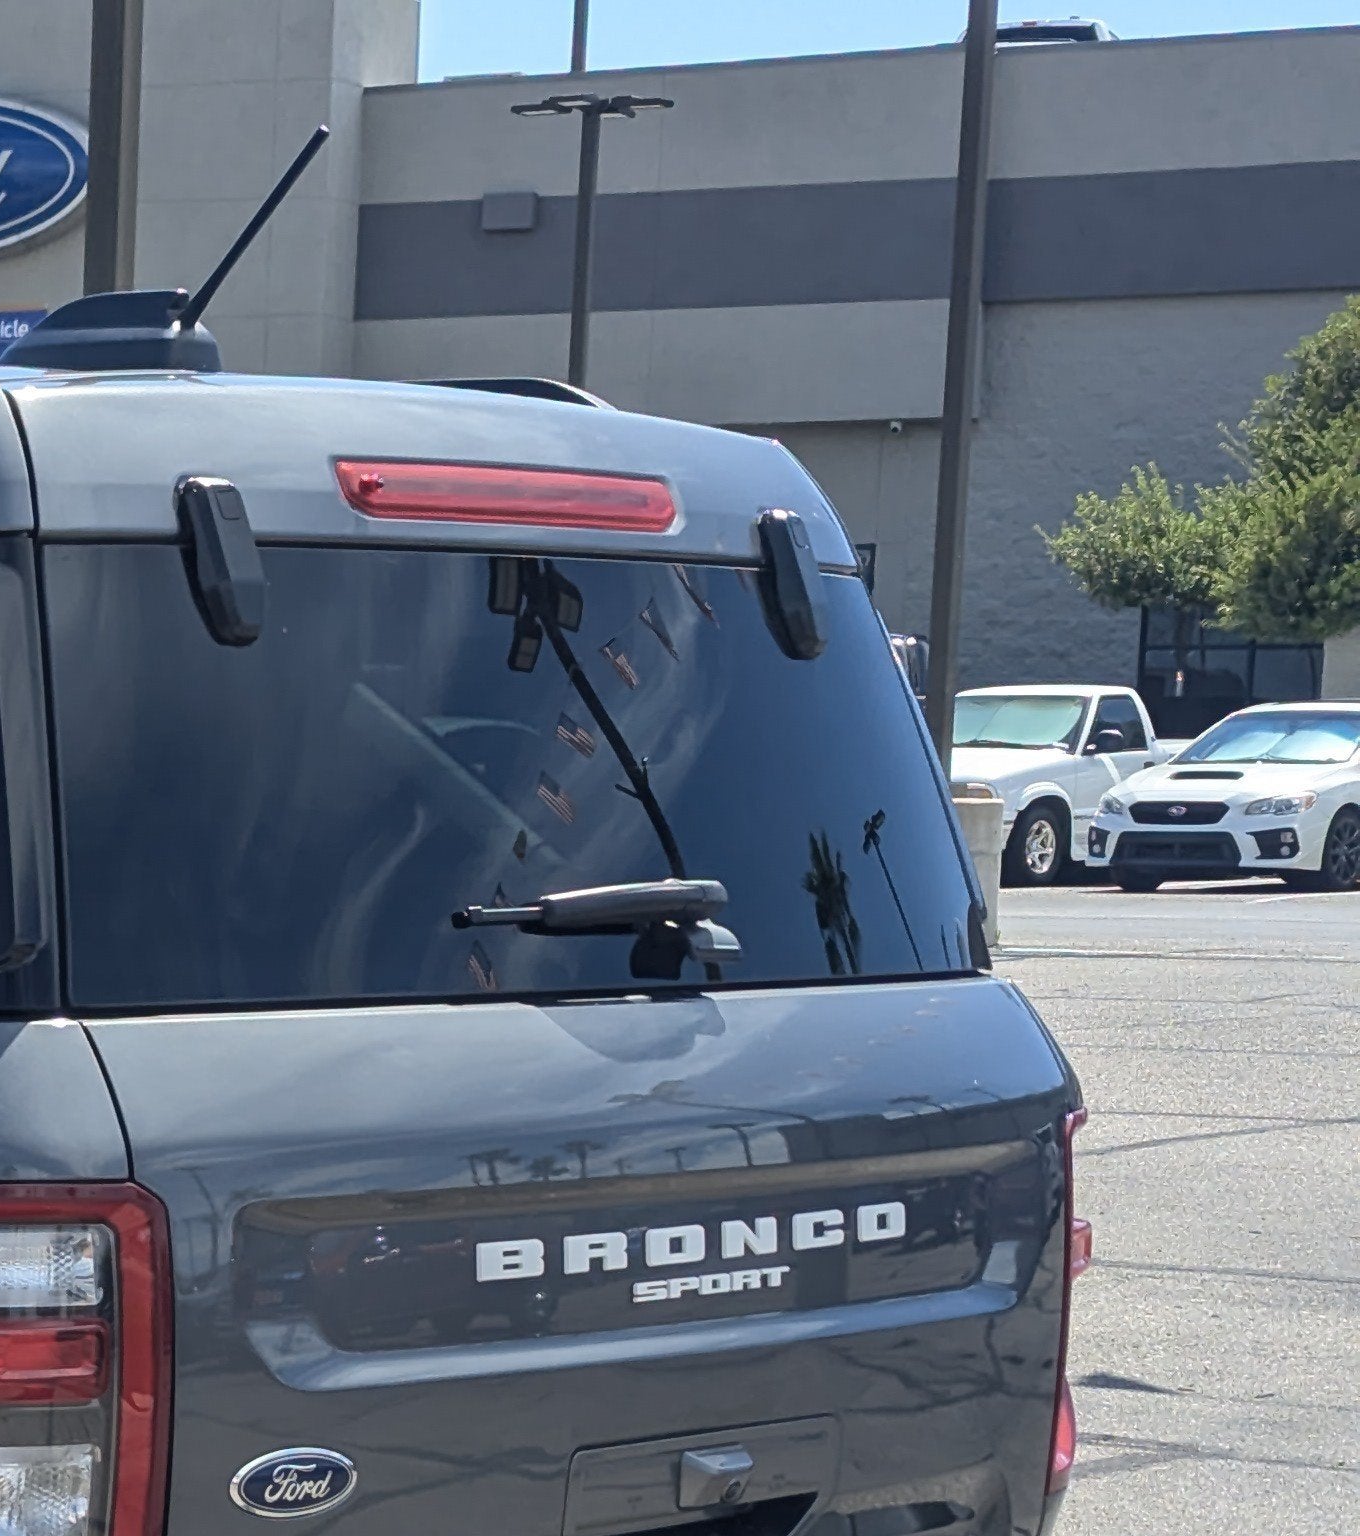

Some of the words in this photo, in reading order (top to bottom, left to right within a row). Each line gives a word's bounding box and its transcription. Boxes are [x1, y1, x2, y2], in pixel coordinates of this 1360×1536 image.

[476, 1202, 906, 1282] BRONCO
[633, 1265, 790, 1303] SPORT
[264, 1463, 333, 1503] Ford
